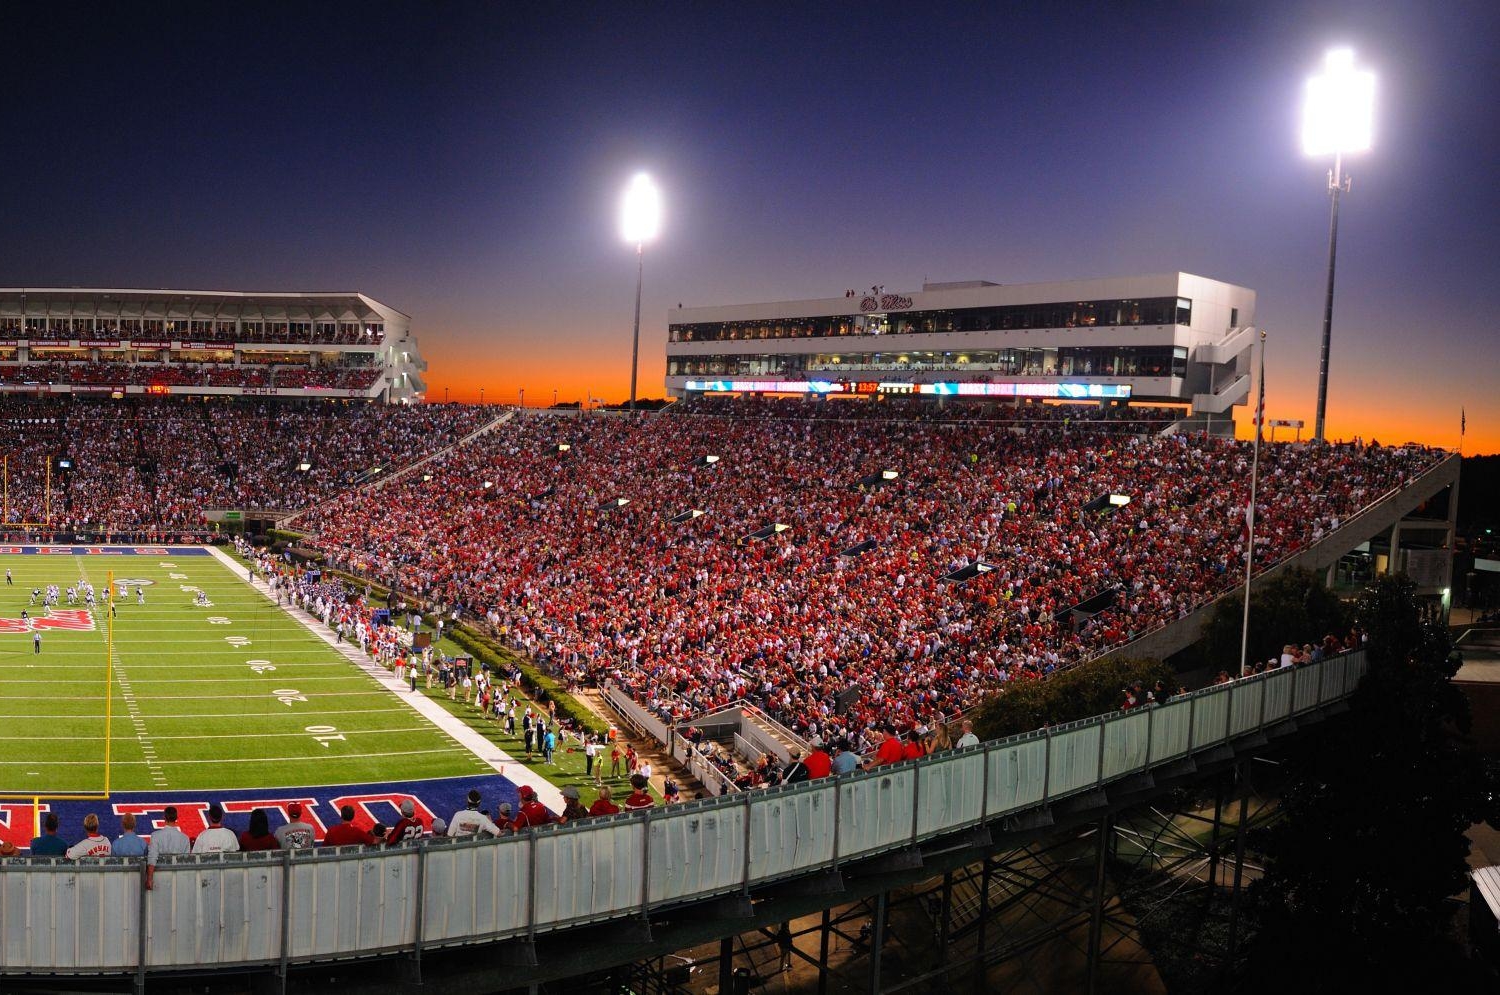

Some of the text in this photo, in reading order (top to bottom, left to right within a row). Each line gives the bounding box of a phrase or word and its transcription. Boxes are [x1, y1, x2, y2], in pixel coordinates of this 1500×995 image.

[860, 294, 914, 312] Ole Miss
[859, 383, 878, 391] 13:57
[206, 616, 232, 624] 50
[224, 636, 252, 646] 40
[246, 660, 276, 671] 30
[272, 689, 308, 702] 20
[304, 725, 346, 741] 10
[112, 792, 438, 843] OLE
[404, 826, 424, 840] 22
